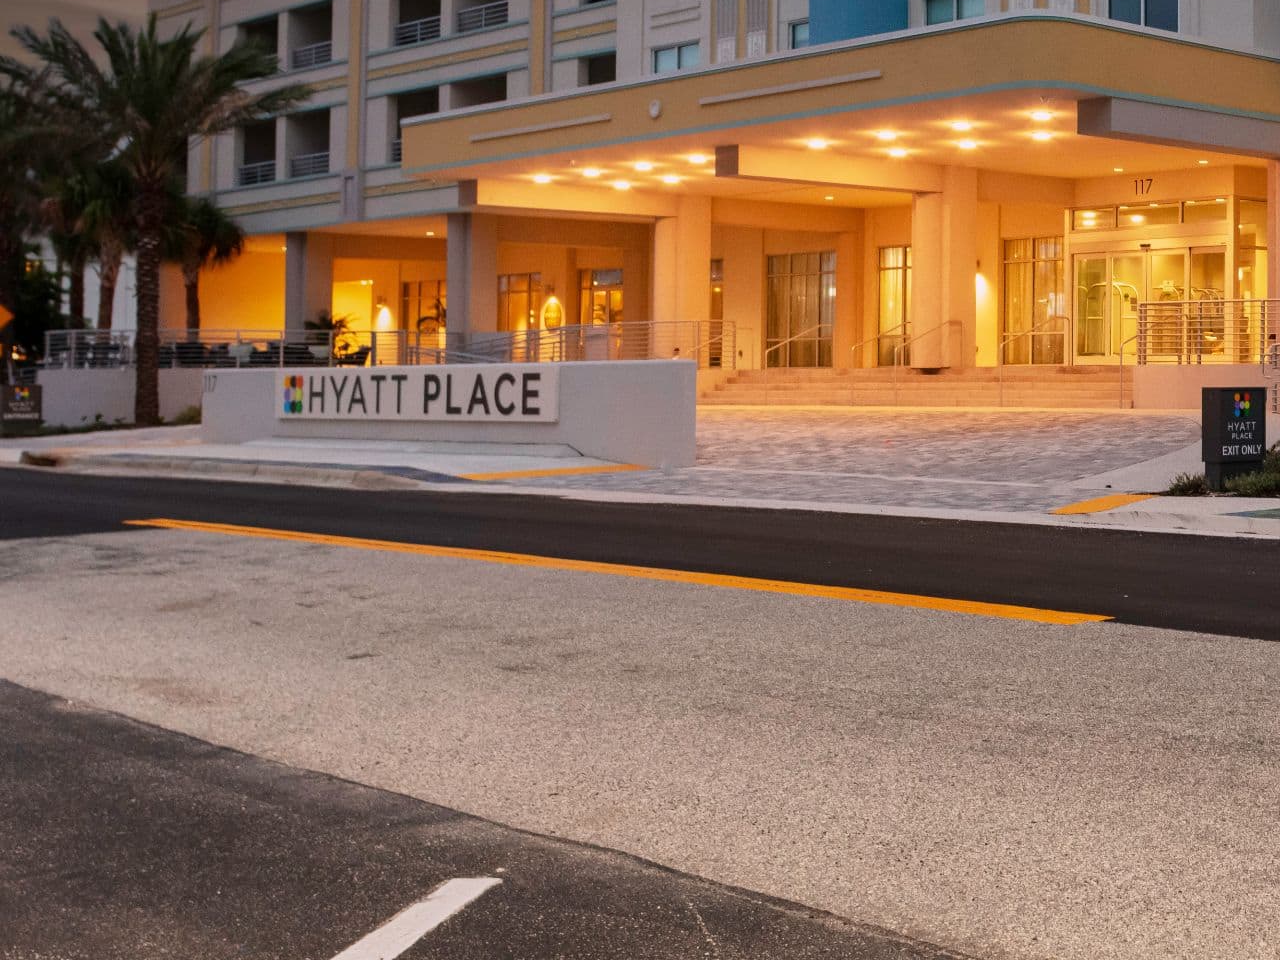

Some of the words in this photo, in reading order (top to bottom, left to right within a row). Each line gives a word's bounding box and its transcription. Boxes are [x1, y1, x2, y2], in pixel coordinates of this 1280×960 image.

[1134, 178, 1153, 195] 117
[308, 375, 407, 414] HYATT
[423, 373, 541, 415] PLACE
[1227, 421, 1257, 431] HYATT
[1231, 432, 1253, 440] PLACE
[1222, 445, 1240, 456] EXIT
[1241, 444, 1262, 455] ONLY
